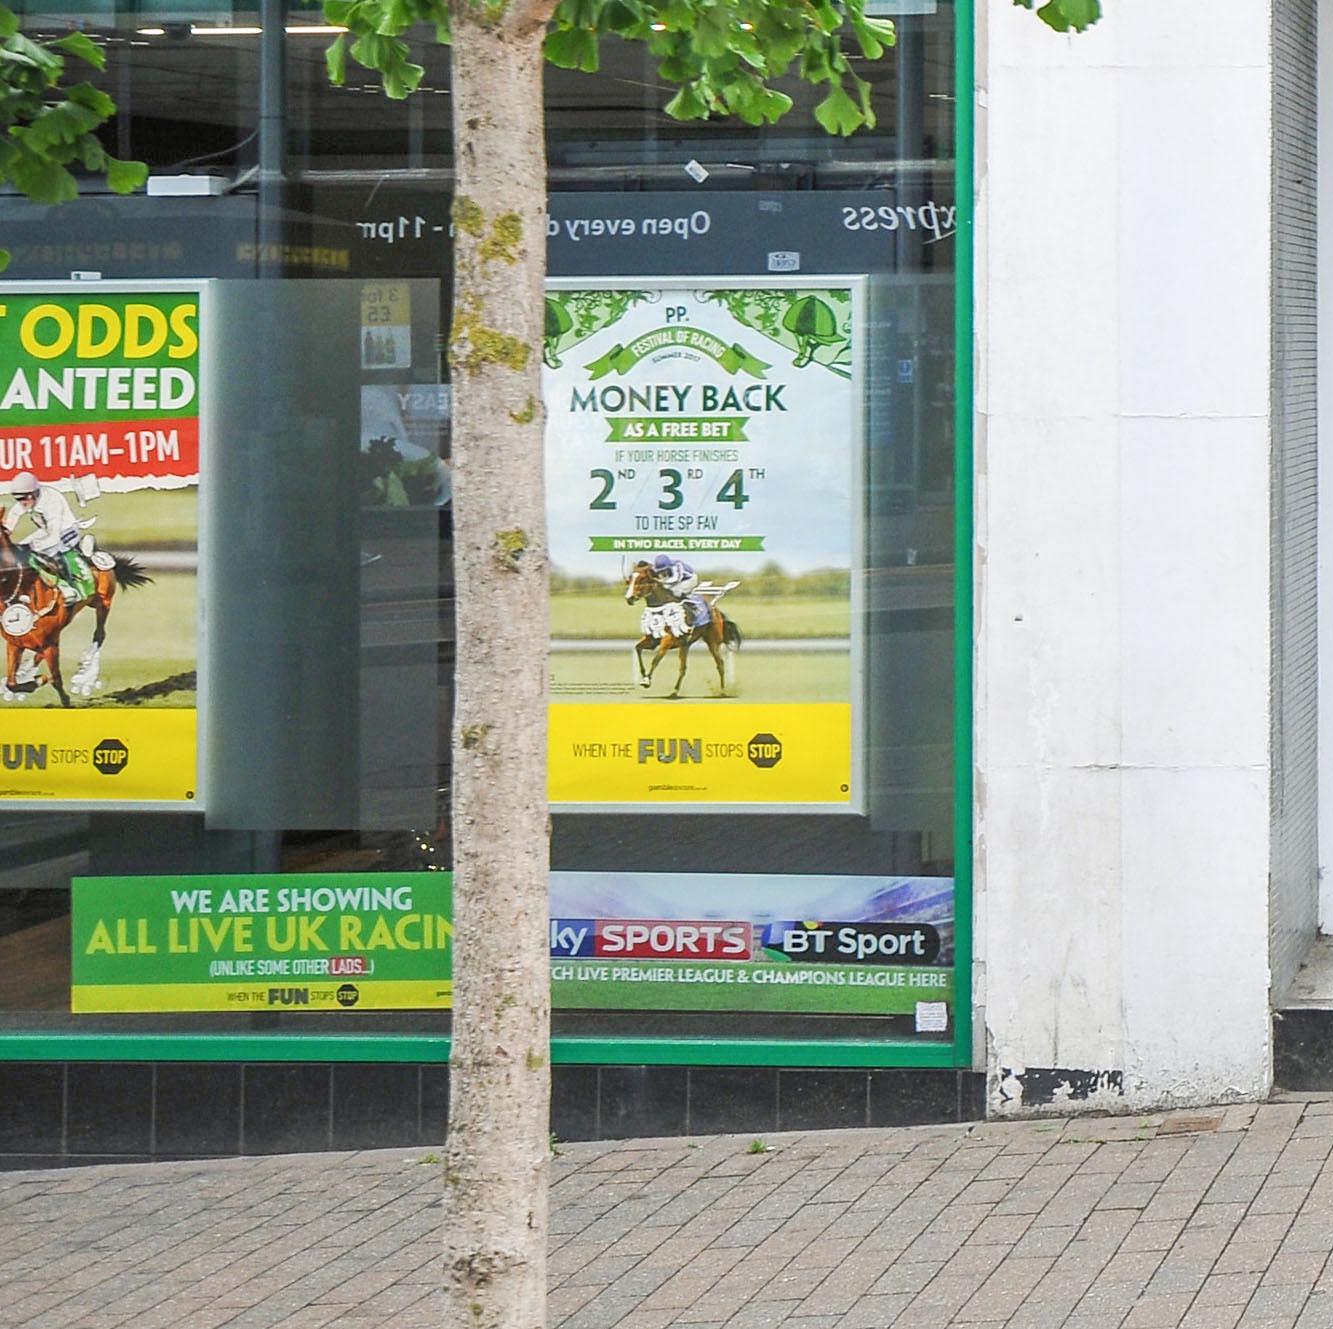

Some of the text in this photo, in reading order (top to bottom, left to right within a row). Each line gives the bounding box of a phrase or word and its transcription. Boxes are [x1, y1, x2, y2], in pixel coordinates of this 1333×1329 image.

[20, 303, 198, 359] ODDS
[632, 330, 726, 357] FESTIVAL OF RACING
[0, 367, 195, 410] ANTEED
[570, 384, 787, 412] MONEY BACK
[624, 422, 731, 437] AS A FREE BET
[40, 430, 180, 468] 11AM-1PM
[615, 450, 738, 462] IF YOUR HORSE FINISHES
[635, 516, 719, 530] TO THE SP FAV
[614, 539, 742, 550] IN TWO RACES, EVERY DAY
[0, 744, 127, 770] UN STOPS STOP
[573, 738, 780, 764] WHEN THE FUN STOPS STOP
[171, 886, 413, 915] WE ARE SHOWING
[85, 915, 331, 955] ALL LIVE UK
[550, 919, 747, 956] ky SPORTS
[783, 926, 926, 960] BT Sport
[209, 957, 330, 977] (UNLIKE SOME OTHER
[578, 966, 946, 988] LIVE PREMIER LEAGUE & CHAMPIONS LEAGUE HERE
[227, 987, 358, 1005] WHEN THE FUN STOPS STOP
